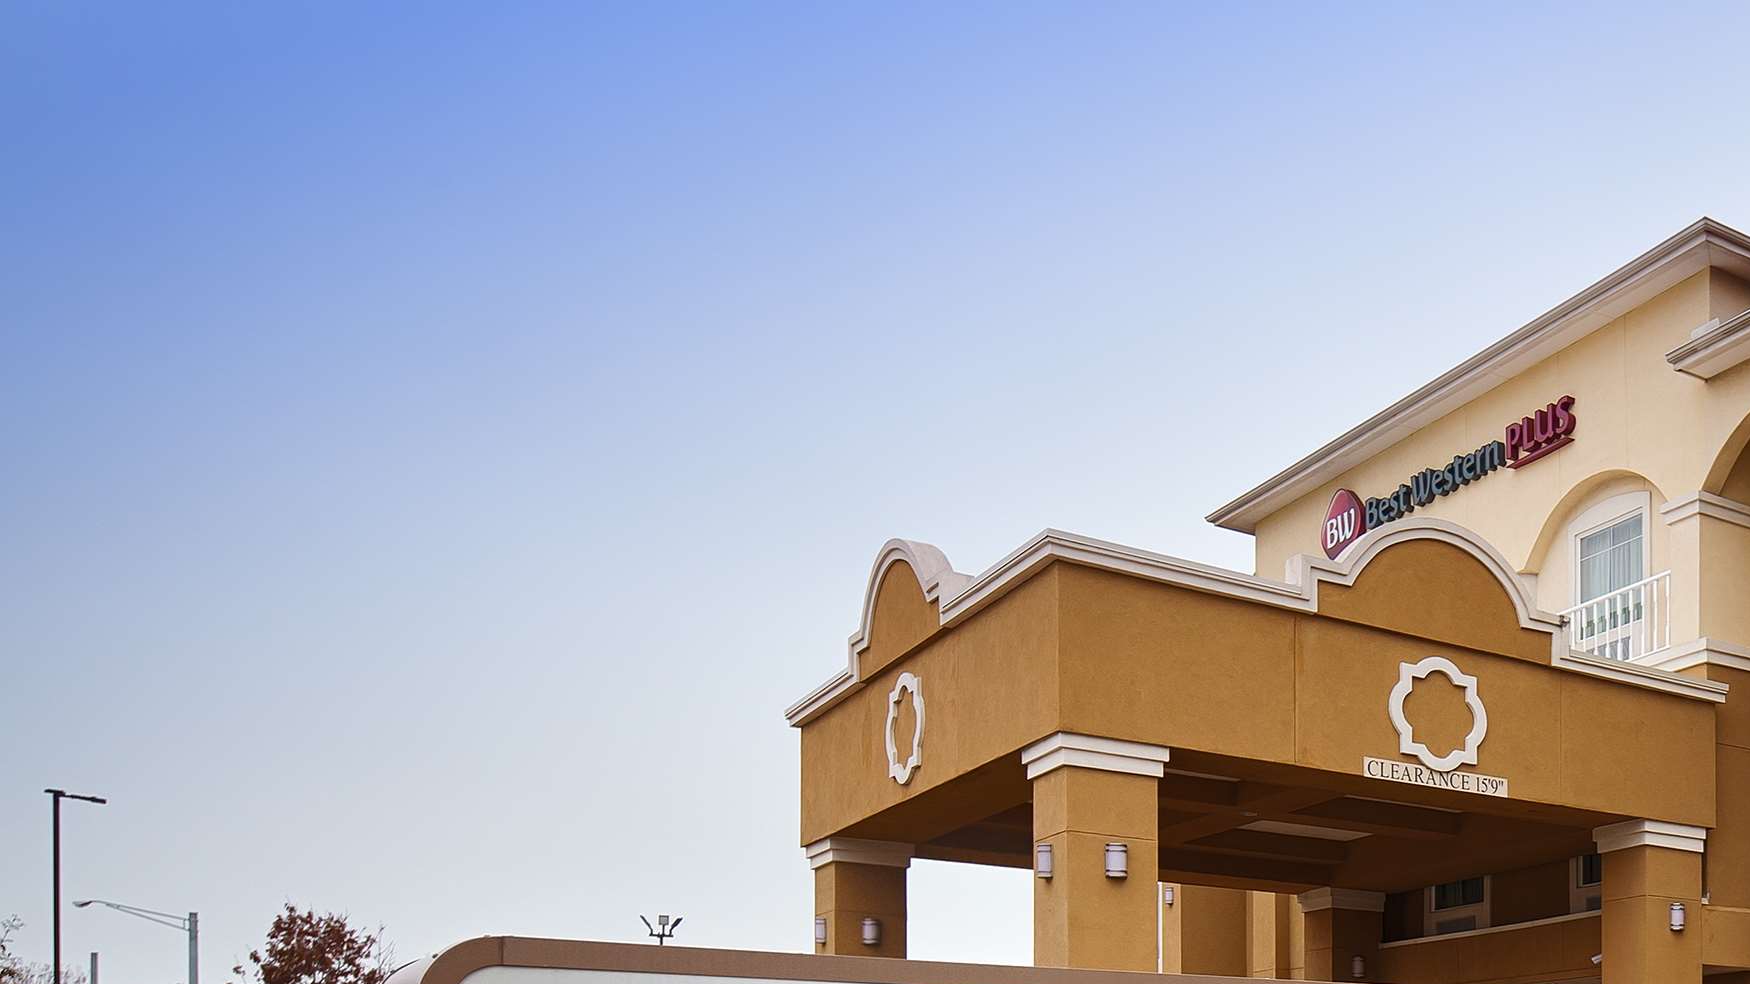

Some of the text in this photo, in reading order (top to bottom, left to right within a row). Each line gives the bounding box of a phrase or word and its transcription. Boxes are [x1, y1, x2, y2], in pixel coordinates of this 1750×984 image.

[1326, 395, 1576, 549] BW Best Western PLUS
[1367, 759, 1470, 791] CLEARANCE
